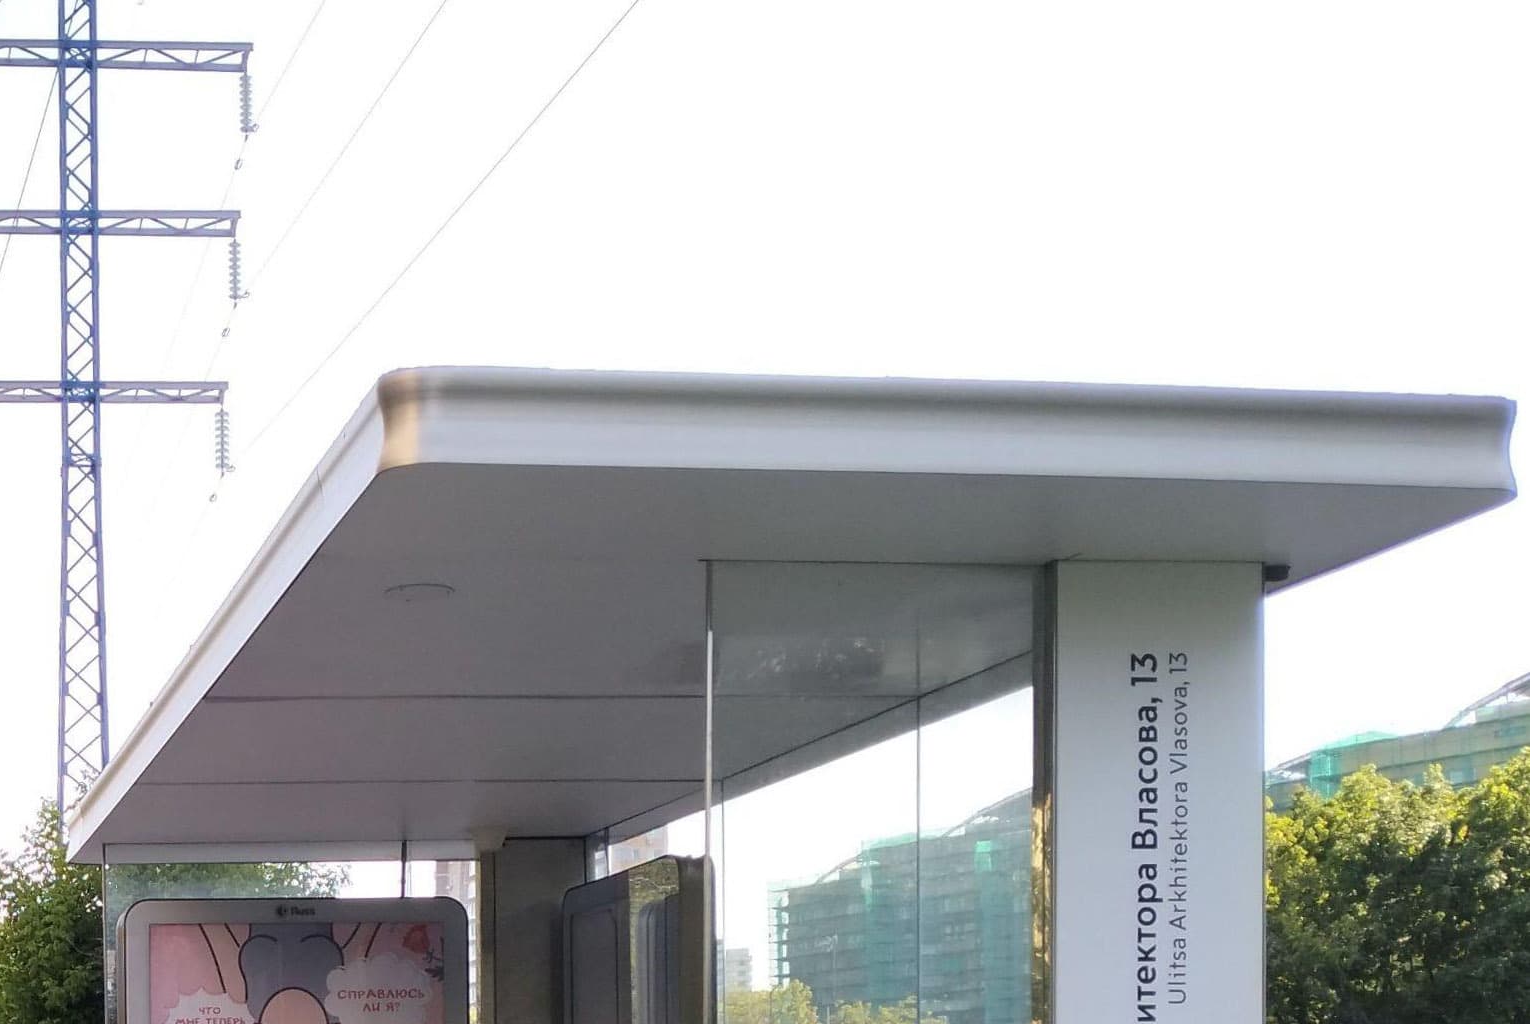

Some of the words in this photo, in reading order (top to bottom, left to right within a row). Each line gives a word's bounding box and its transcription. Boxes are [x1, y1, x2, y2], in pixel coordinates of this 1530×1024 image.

[1131, 653, 1158, 686] 13
[1169, 652, 1188, 674] 13
[1169, 681, 1190, 775] Vlasova,
[1131, 697, 1163, 850] Власова,
[1168, 782, 1188, 930] Arkhitektora
[1168, 937, 1187, 1004] Ulitsa
[198, 1006, 221, 1015] ЧТО
[363, 1002, 380, 1012] ЛИ
